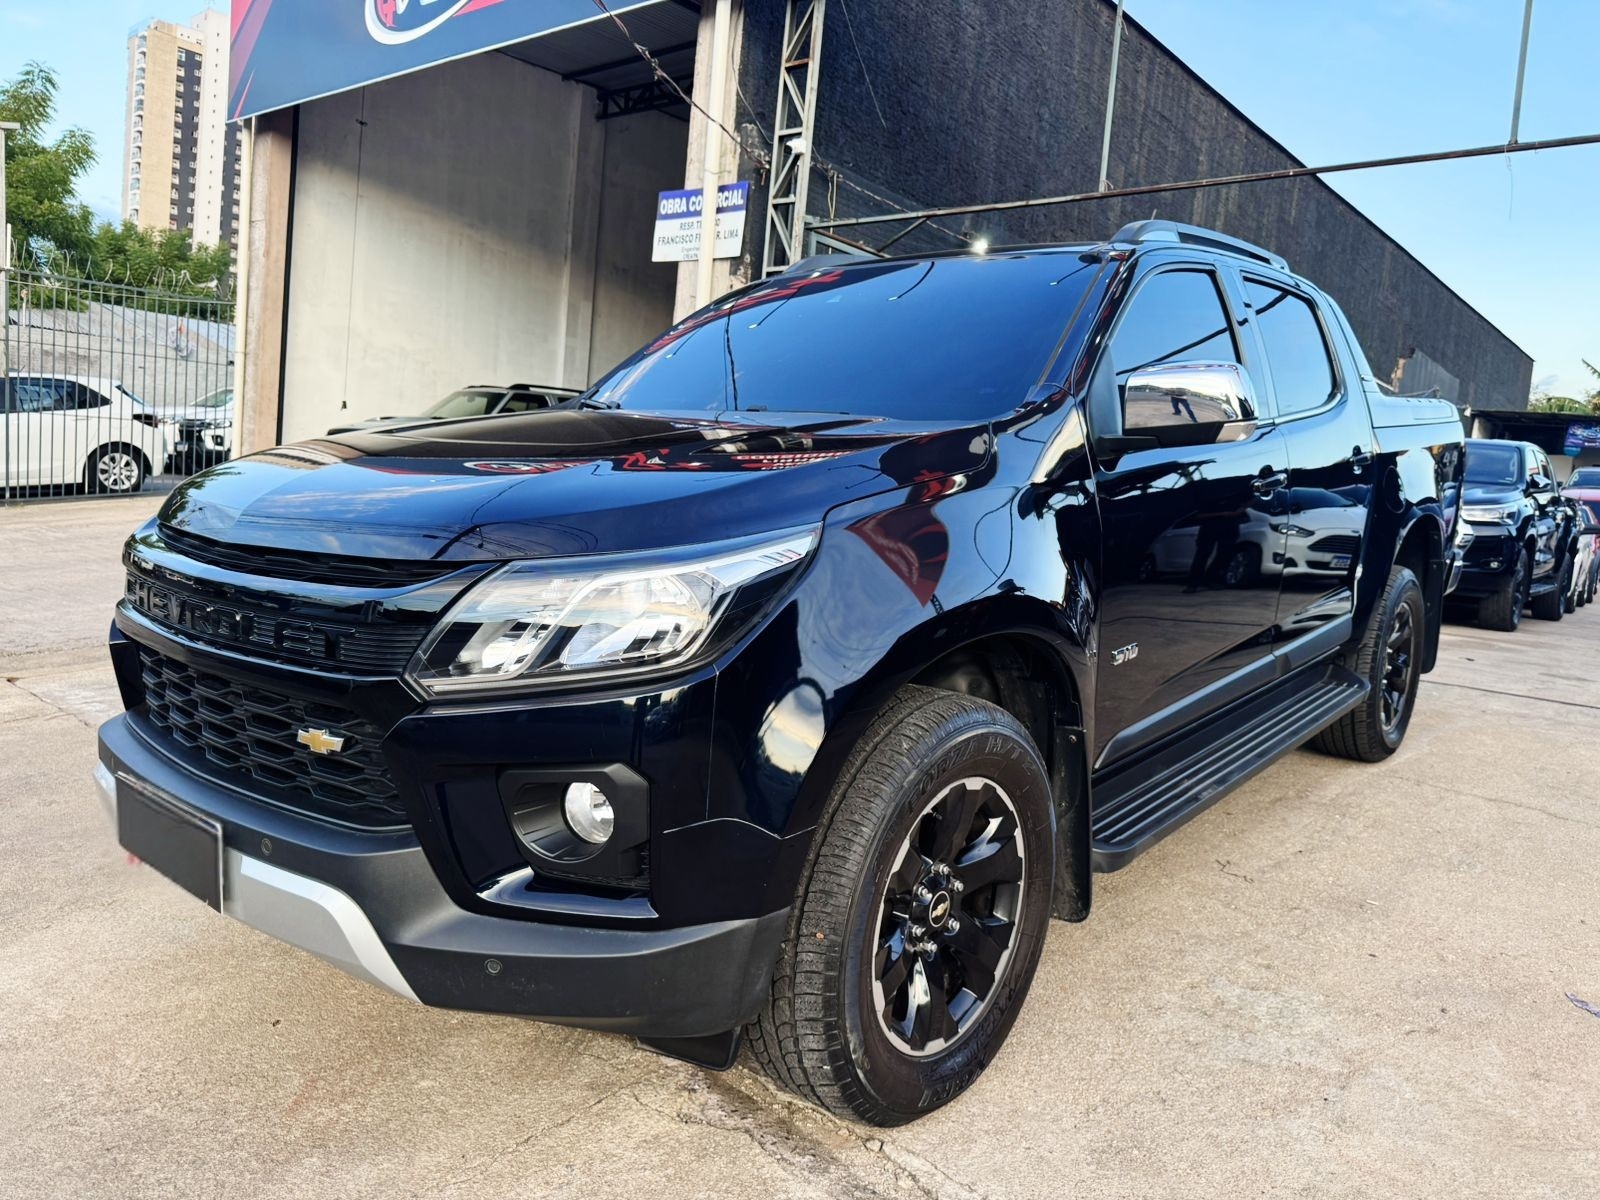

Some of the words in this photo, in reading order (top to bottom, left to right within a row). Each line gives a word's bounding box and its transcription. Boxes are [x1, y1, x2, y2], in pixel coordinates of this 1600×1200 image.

[660, 197, 686, 215] OBRA
[689, 189, 744, 212] CORCIAL
[657, 234, 693, 246] FRANCISCO
[126, 572, 355, 660] CHEVROLET
